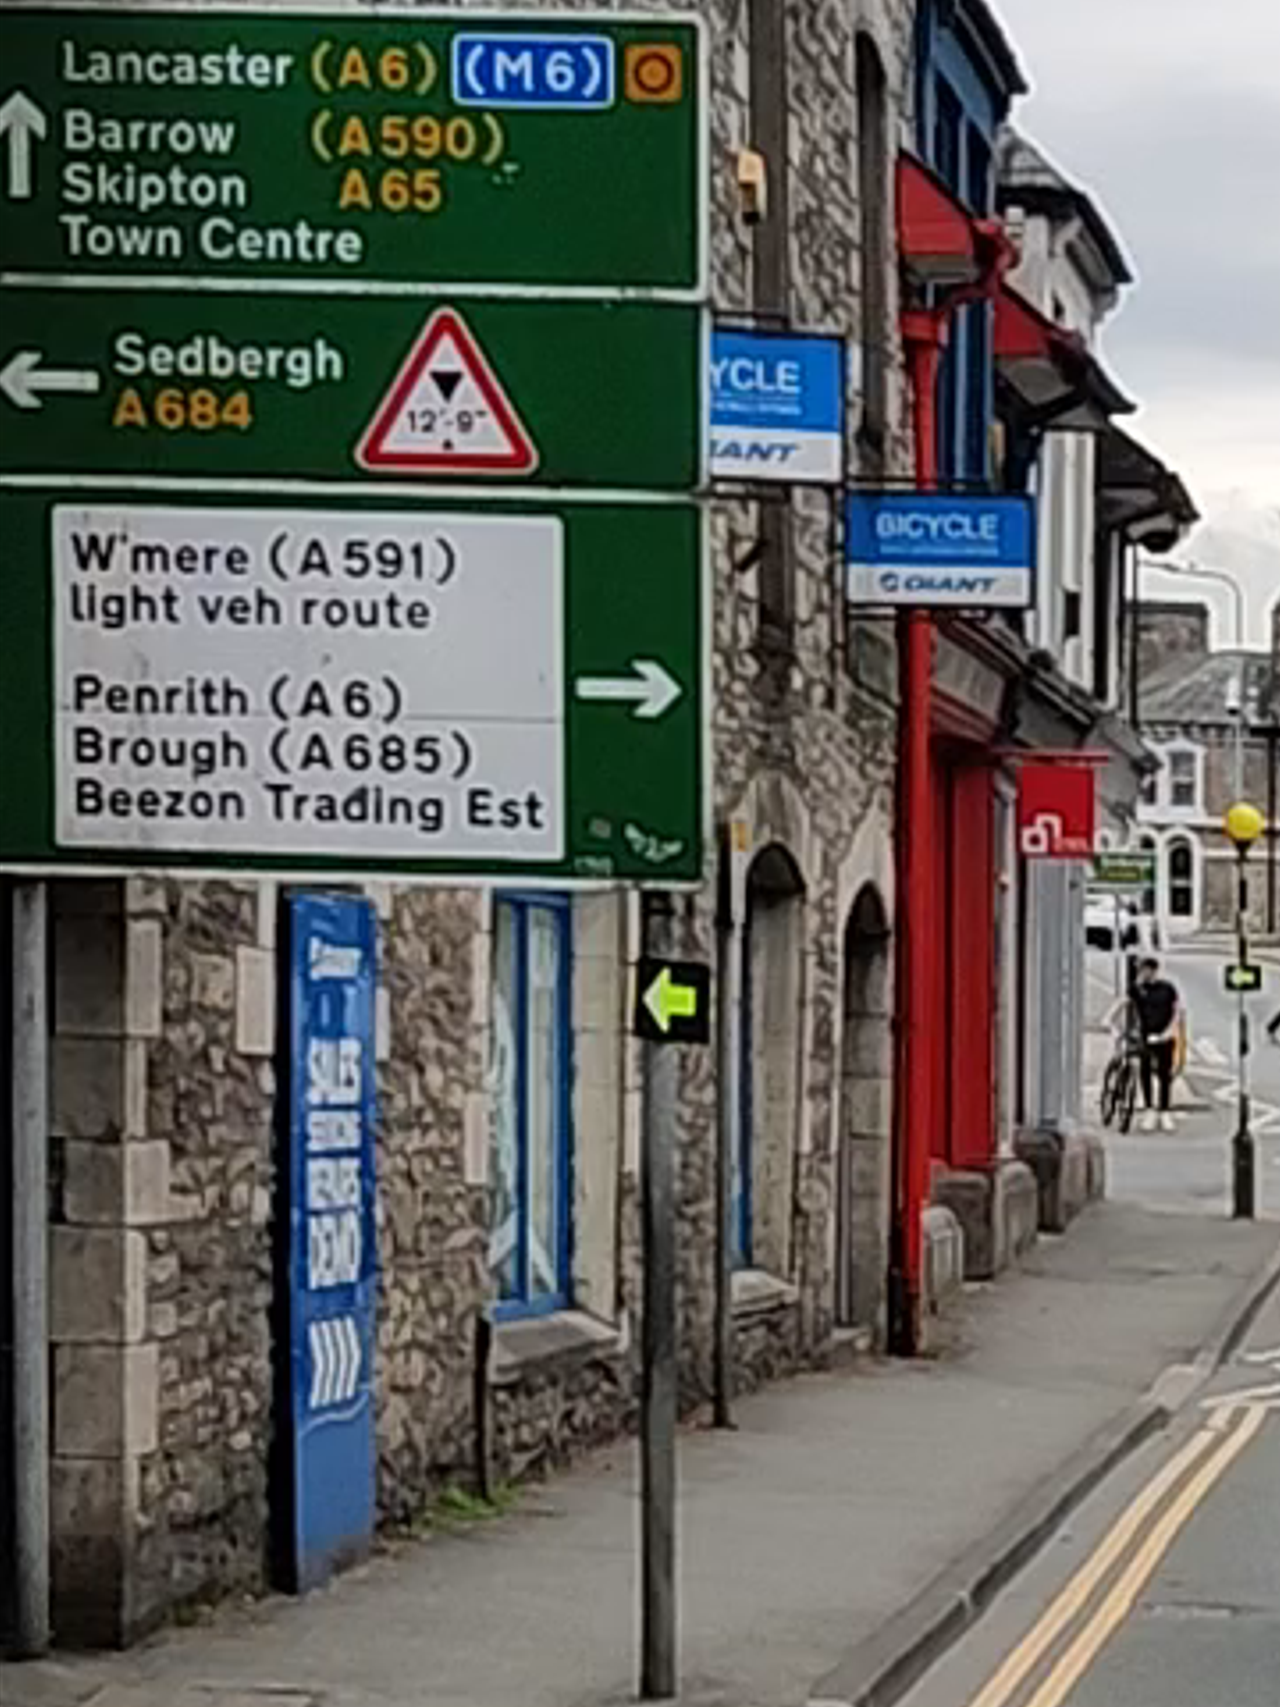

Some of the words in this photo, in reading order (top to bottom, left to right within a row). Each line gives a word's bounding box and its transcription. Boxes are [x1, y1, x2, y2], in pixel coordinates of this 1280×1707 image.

[62, 40, 294, 87] Lancaster
[311, 41, 437, 94] (A6)
[464, 43, 601, 97] (M6)
[63, 108, 235, 153] Barrow
[311, 109, 504, 165] (A590)
[61, 161, 247, 212] Skipton
[338, 168, 443, 212] A65
[59, 213, 182, 256] Town
[199, 216, 363, 262] Centre
[113, 333, 343, 388] Sedbergh
[711, 358, 801, 393] YCLE
[112, 388, 253, 430] A684
[876, 511, 999, 541] BICYCLE
[70, 531, 250, 575] W'mere
[269, 532, 457, 586] (A591)
[904, 572, 997, 593] GIANT
[70, 582, 181, 631] light
[197, 587, 283, 626] veh
[301, 592, 431, 629] route
[73, 674, 249, 717] Penrith
[269, 674, 402, 724] (A6)
[74, 726, 248, 779] Brough
[269, 727, 471, 780] (A685)
[75, 777, 246, 820] Beezon
[262, 782, 445, 833] Trading
[465, 787, 545, 829] Est
